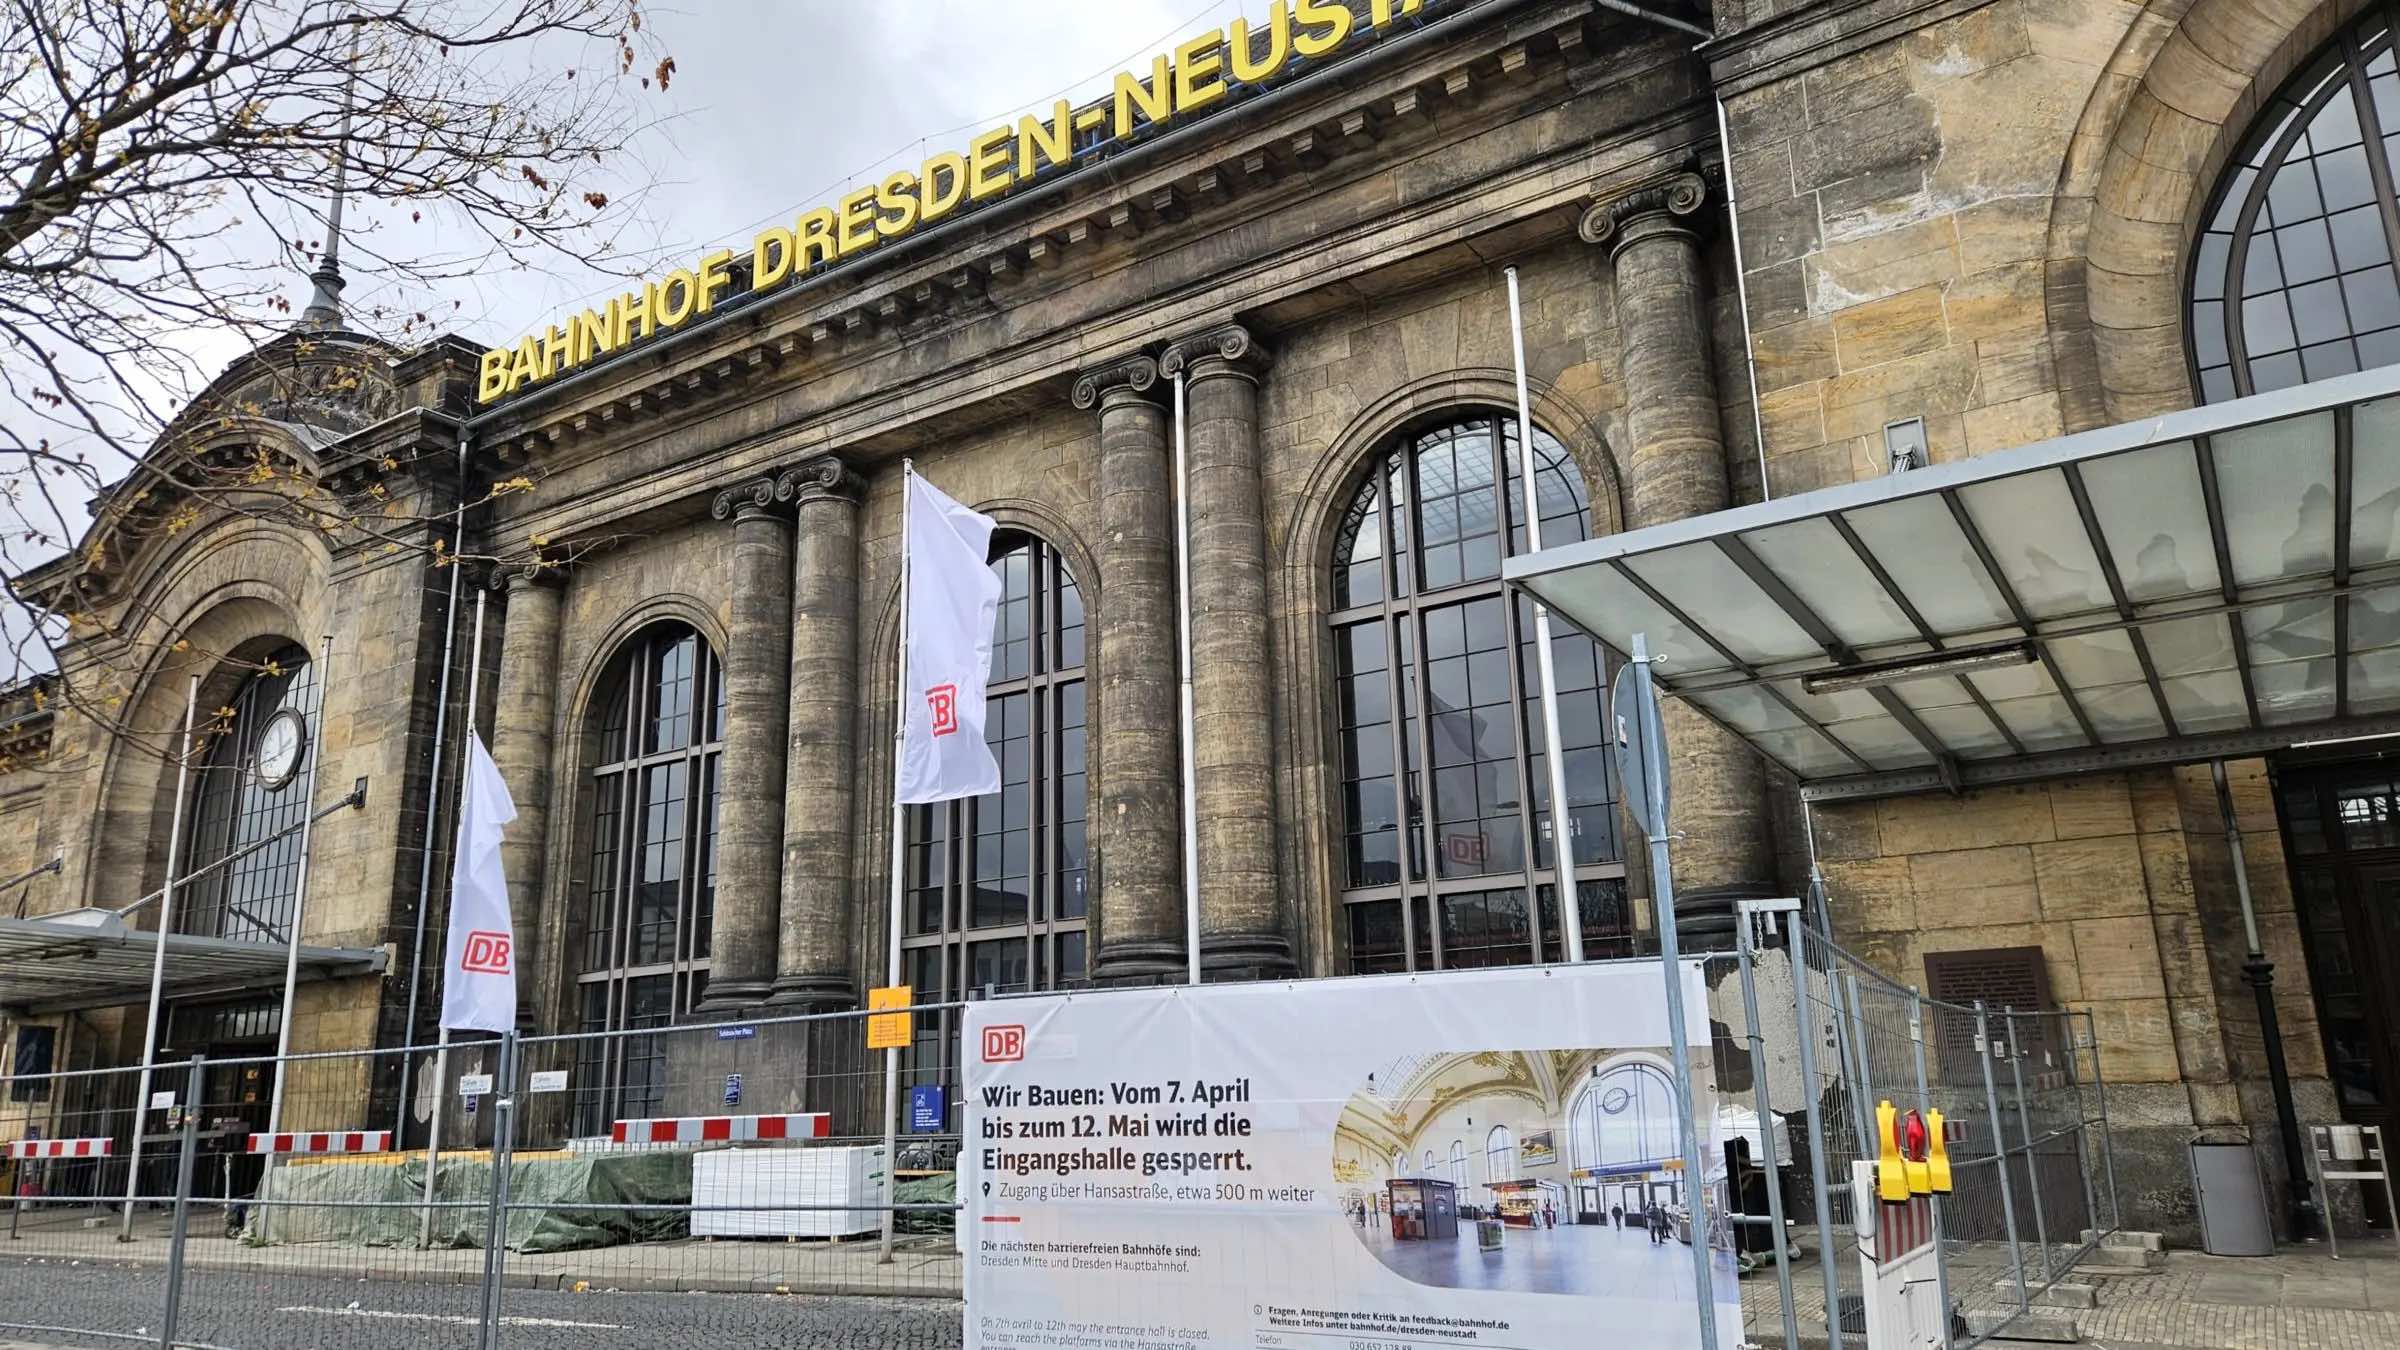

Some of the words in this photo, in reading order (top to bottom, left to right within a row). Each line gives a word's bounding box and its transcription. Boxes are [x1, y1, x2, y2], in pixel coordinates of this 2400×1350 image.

[478, 248, 733, 404] BAHNHOF
[752, 0, 1424, 292] DRESDEN-NEUS
[468, 938, 511, 967] DB
[987, 1031, 1021, 1057] DB
[982, 1085, 1021, 1108] Wir
[1028, 1084, 1104, 1108] Bauen:
[1110, 1082, 1160, 1105] Vom
[1167, 1080, 1185, 1103] 7.
[1192, 1078, 1249, 1108] April
[982, 1116, 1013, 1139] bis
[1018, 1120, 1065, 1138] zum
[1071, 1116, 1102, 1138] 12.
[1109, 1114, 1149, 1137] Mai
[1155, 1112, 1207, 1136] wird
[1213, 1111, 1251, 1136] die
[982, 1147, 1136, 1176] Eingangshalle
[1142, 1149, 1252, 1176] gesperrt.
[999, 1182, 1048, 1202] Zugang
[1051, 1182, 1080, 1200] über
[1084, 1182, 1173, 1202] Hansastraße,
[1176, 1186, 1211, 1201] etwa
[1215, 1184, 1245, 1201] 500
[1249, 1188, 1263, 1201] m
[1267, 1185, 1315, 1202] weiter
[981, 1240, 997, 1252] Die
[1000, 1240, 1045, 1254] nächsten
[1047, 1241, 1120, 1256] barrierefreien
[1122, 1242, 1172, 1257] Bahnhöfe
[1175, 1244, 1201, 1258] sind:
[981, 1255, 1019, 1269] Dresden
[1022, 1256, 1048, 1269] Mitte
[1050, 1257, 1069, 1270] und
[1072, 1257, 1111, 1271] Dresden
[1115, 1259, 1189, 1274] Hauptbahnhof.
[981, 1317, 993, 1328] On
[996, 1318, 1009, 1329] 7th
[1034, 1320, 1043, 1330] to
[1046, 1321, 1066, 1332] 12th
[1069, 1323, 1087, 1334] may
[1090, 1322, 1104, 1334] the
[1107, 1325, 1145, 1336] entrance
[1149, 1325, 1165, 1337] hall
[1168, 1327, 1175, 1338] is
[1178, 1328, 1210, 1341] closed.
[1269, 1306, 1299, 1318] Fragen,
[1301, 1308, 1349, 1321] Anregungen
[1351, 1312, 1371, 1321] oder
[1373, 1312, 1397, 1323] Kritik
[1412, 1315, 1510, 1331] feedback@bahnhof.de
[1269, 1318, 1301, 1328] Weitere
[1303, 1319, 1324, 1329] Infos
[1326, 1321, 1348, 1331] unter
[1350, 1321, 1477, 1339] bahnhof.de/dresden-neustadt
[981, 1330, 996, 1341] You
[998, 1333, 1013, 1343] can
[1016, 1333, 1040, 1344] reach
[1043, 1333, 1057, 1345] the
[1059, 1335, 1102, 1348] platforms
[1104, 1338, 1118, 1348] via
[1121, 1338, 1135, 1350] the
